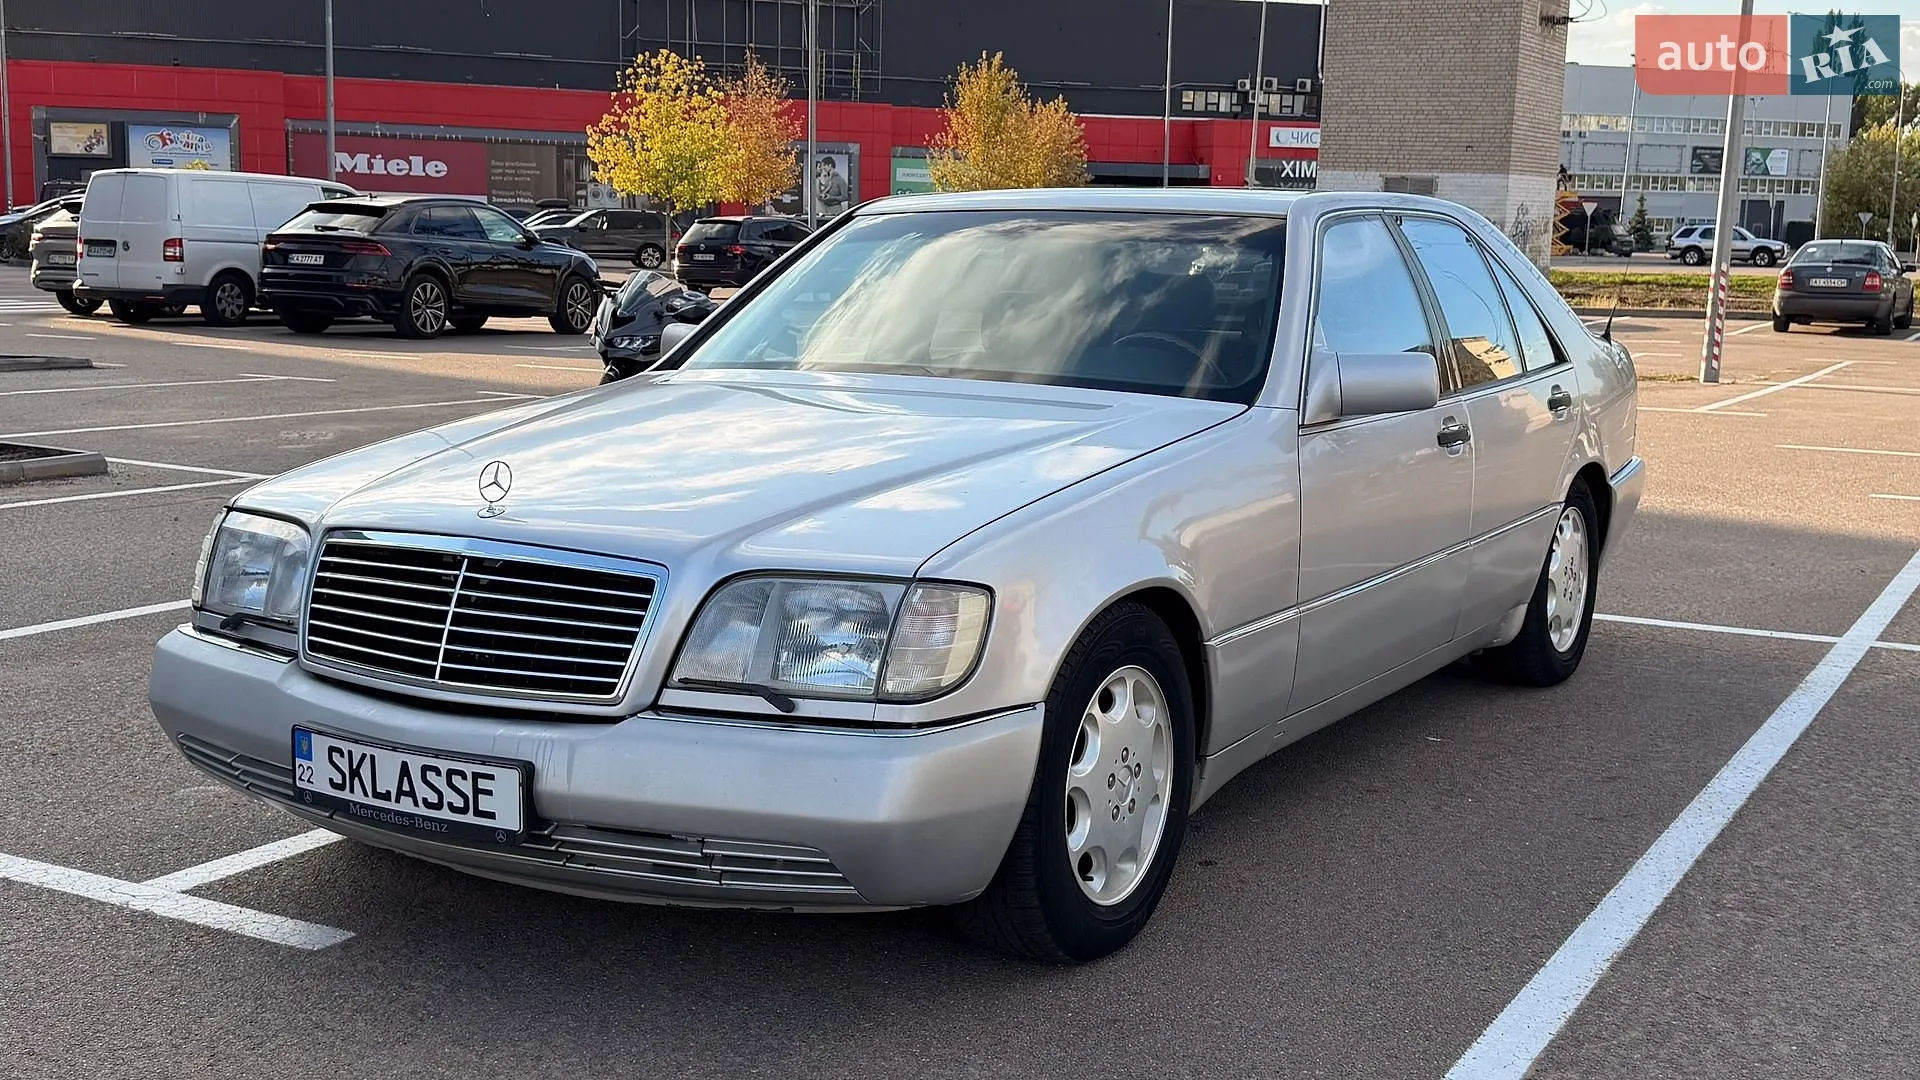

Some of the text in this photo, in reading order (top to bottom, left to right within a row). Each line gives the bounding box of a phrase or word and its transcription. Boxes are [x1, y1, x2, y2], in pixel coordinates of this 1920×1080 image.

[334, 151, 448, 178] Miele
[297, 745, 497, 821] 22 SKLASSE
[349, 802, 449, 833] Mercedes-Benz
